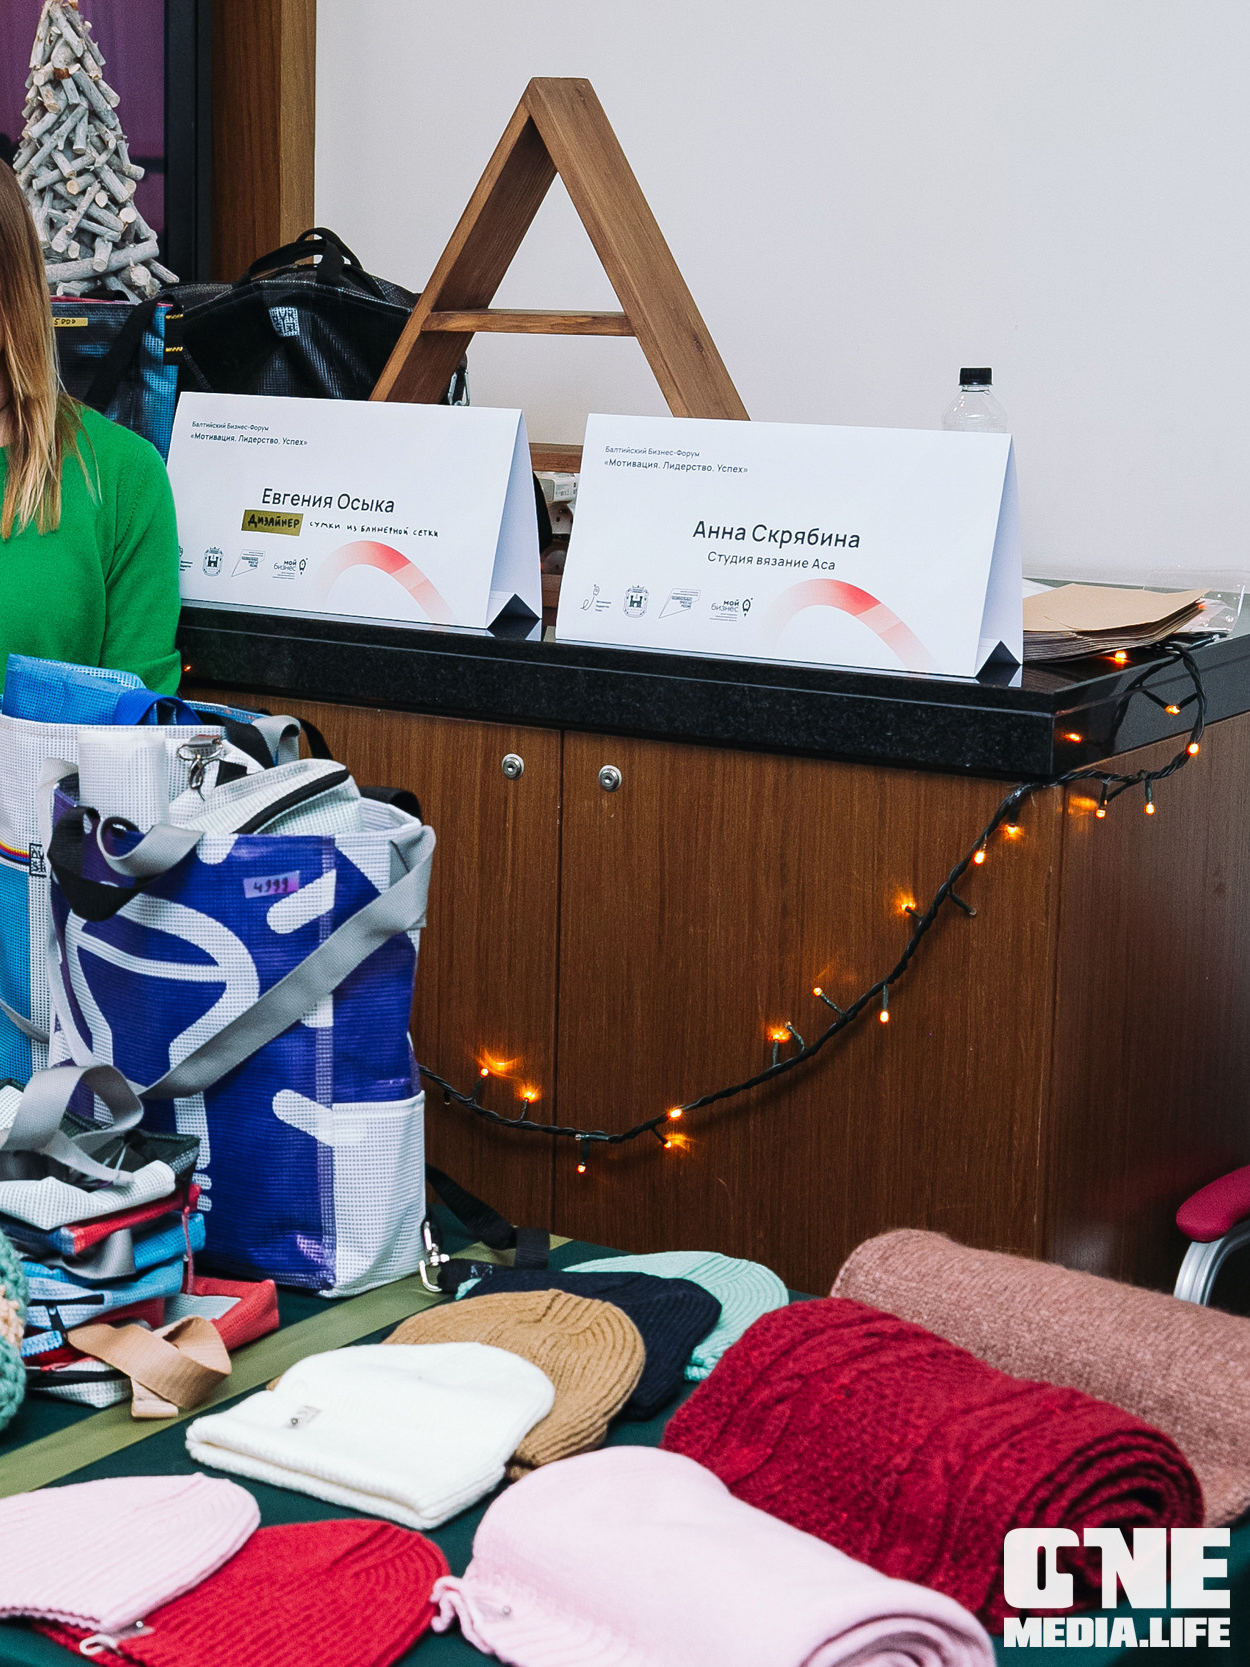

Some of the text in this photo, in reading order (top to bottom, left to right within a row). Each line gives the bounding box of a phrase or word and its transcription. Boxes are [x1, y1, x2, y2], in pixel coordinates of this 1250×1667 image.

[191, 421, 269, 432] Балтийский Бизнес-Форум
[190, 432, 308, 446] «Мотивация. Лидерство. Успех»
[605, 446, 700, 458] Балтийский Бизнес-Форум
[604, 459, 748, 473] «Мотивация. Лидерство. Успех»
[261, 488, 395, 513] Евгения Осыка
[693, 521, 861, 549] Анна Скрябина
[707, 551, 836, 570] Студия вязание Аса
